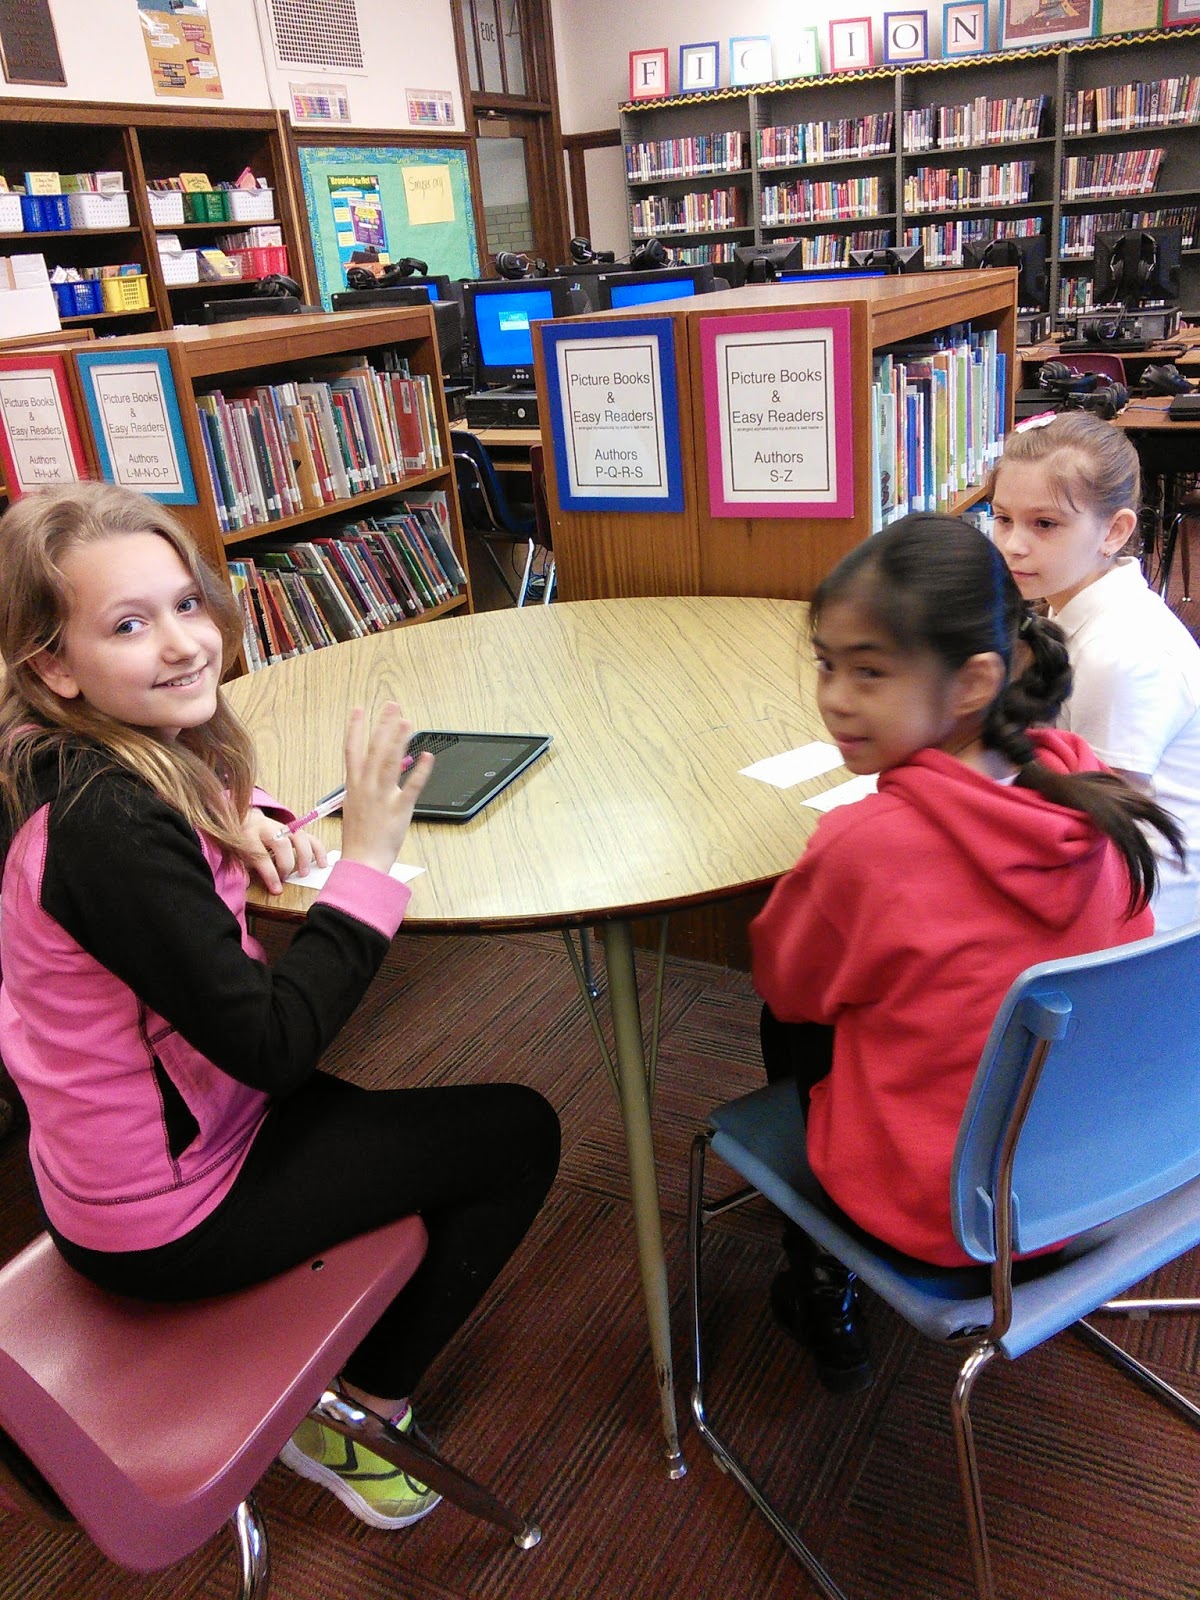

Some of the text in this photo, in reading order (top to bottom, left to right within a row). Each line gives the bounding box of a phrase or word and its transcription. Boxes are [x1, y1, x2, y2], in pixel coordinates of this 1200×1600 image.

[641, 14, 979, 86] FICION
[571, 372, 650, 386] Picture Books
[732, 369, 822, 384] Picture Books
[103, 392, 158, 403] Picture Books
[607, 392, 615, 403] &
[772, 390, 780, 402] &
[4, 397, 54, 408] Picture Books
[29, 412, 35, 421] &
[130, 408, 136, 417] &
[574, 410, 653, 425] Easy Readers
[733, 409, 823, 426] Easy Readers
[11, 425, 61, 437] Easy Readers
[110, 422, 165, 435] Easy Readers
[30, 456, 56, 464] Authors
[129, 454, 158, 463] Authors
[595, 449, 637, 460] Authors
[754, 451, 803, 463] Authors
[34, 469, 60, 478] H-I-J-K
[126, 468, 168, 477] L-M-N-O-P
[596, 466, 643, 478] P-Q-R-S
[770, 470, 793, 482] S-Z
